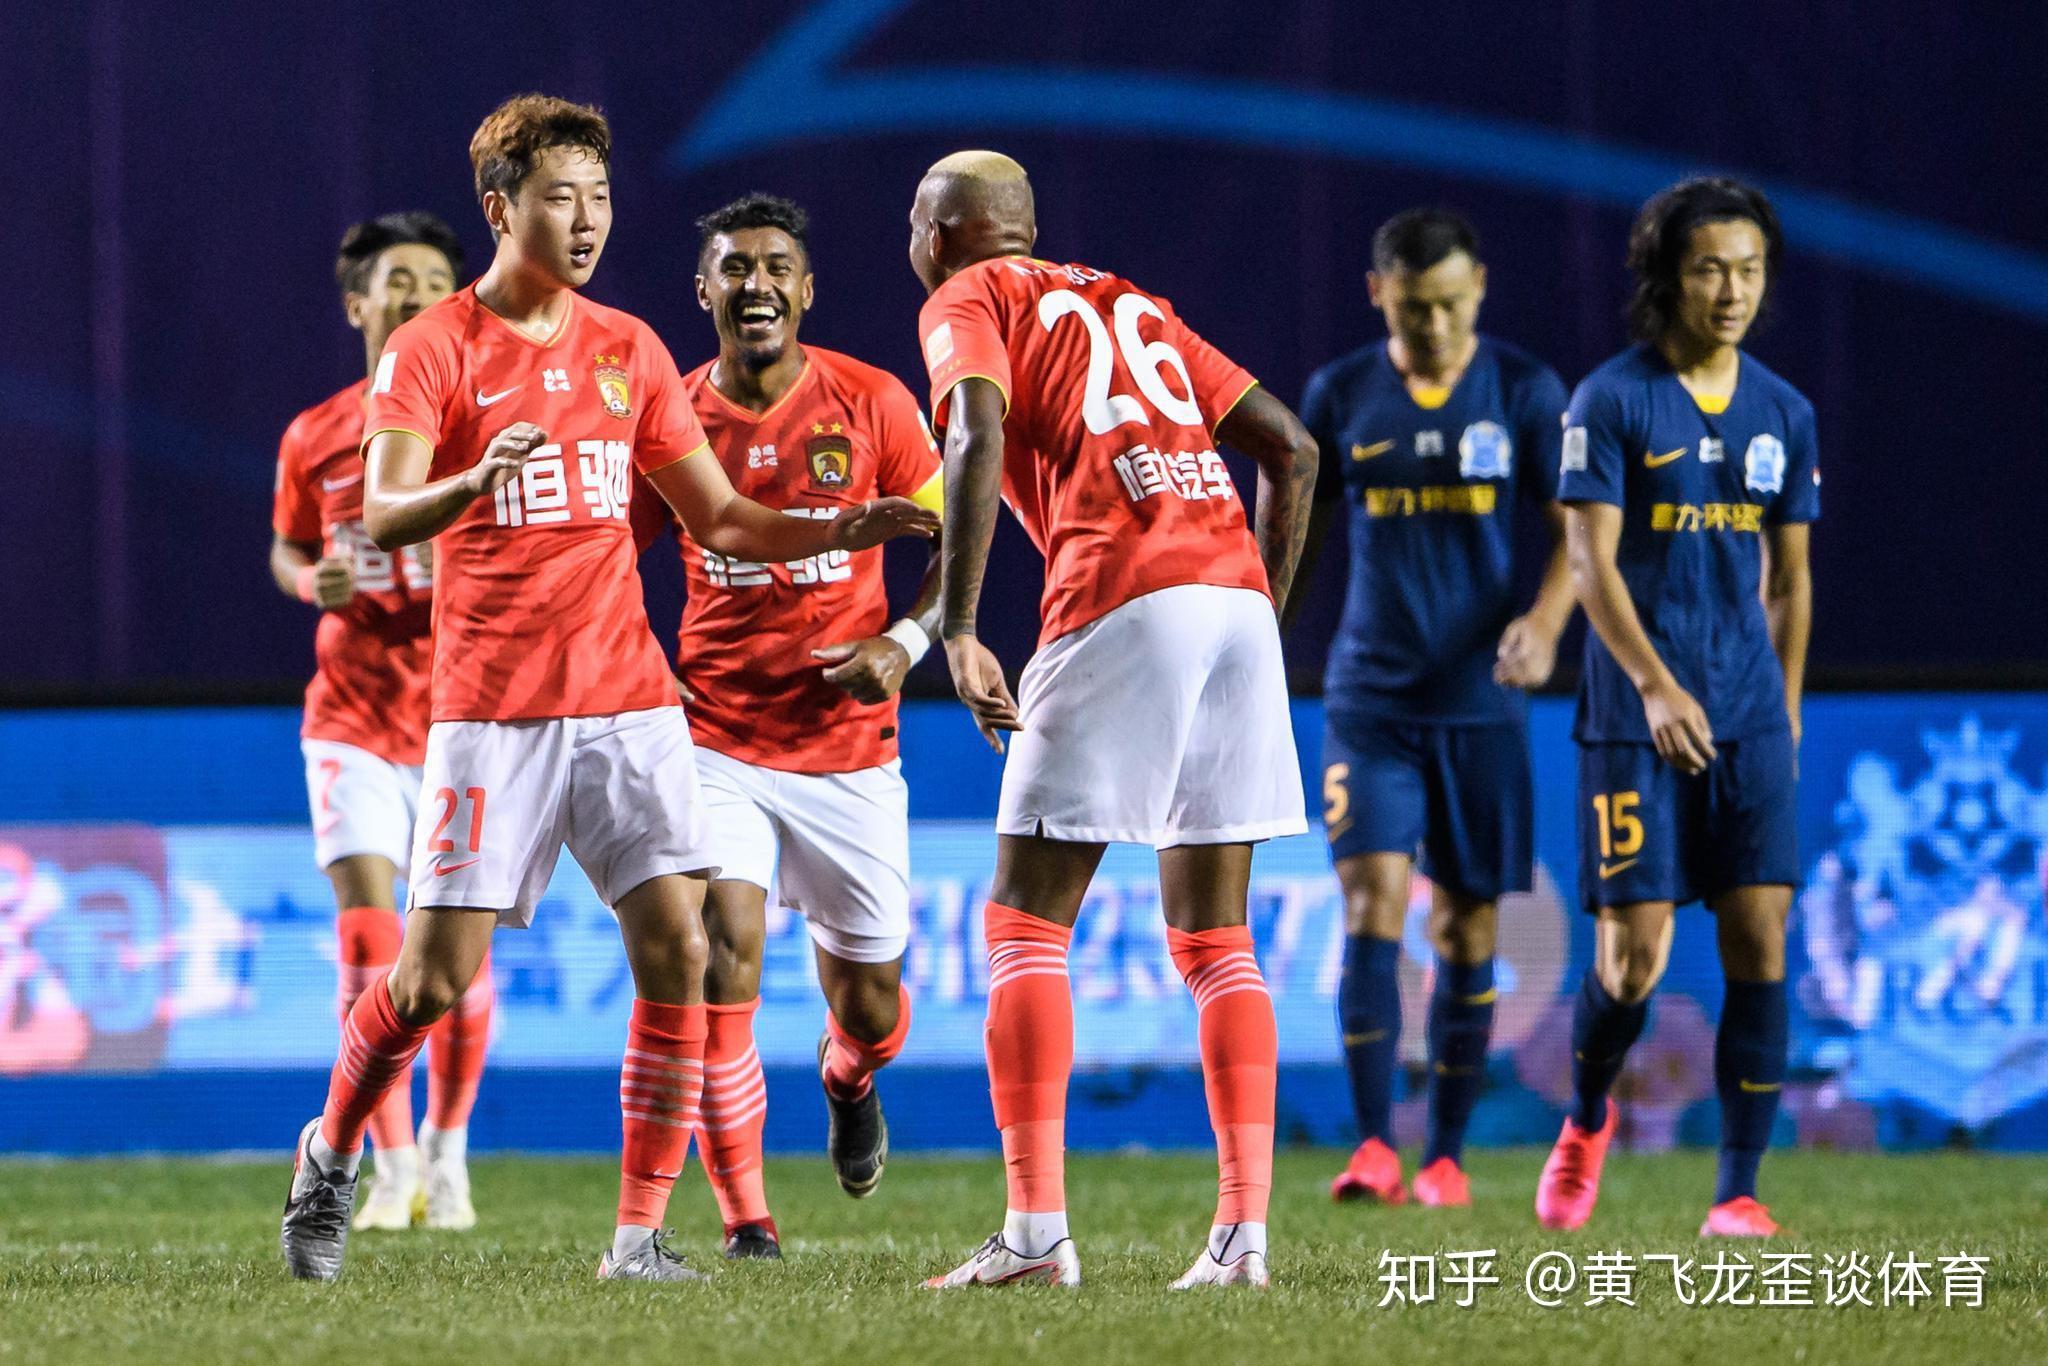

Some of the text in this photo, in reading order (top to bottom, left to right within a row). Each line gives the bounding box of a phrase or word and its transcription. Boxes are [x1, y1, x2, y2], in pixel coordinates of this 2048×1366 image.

[1038, 288, 1204, 436] 26
[428, 786, 487, 853] 21
[1593, 791, 1645, 858] 15
